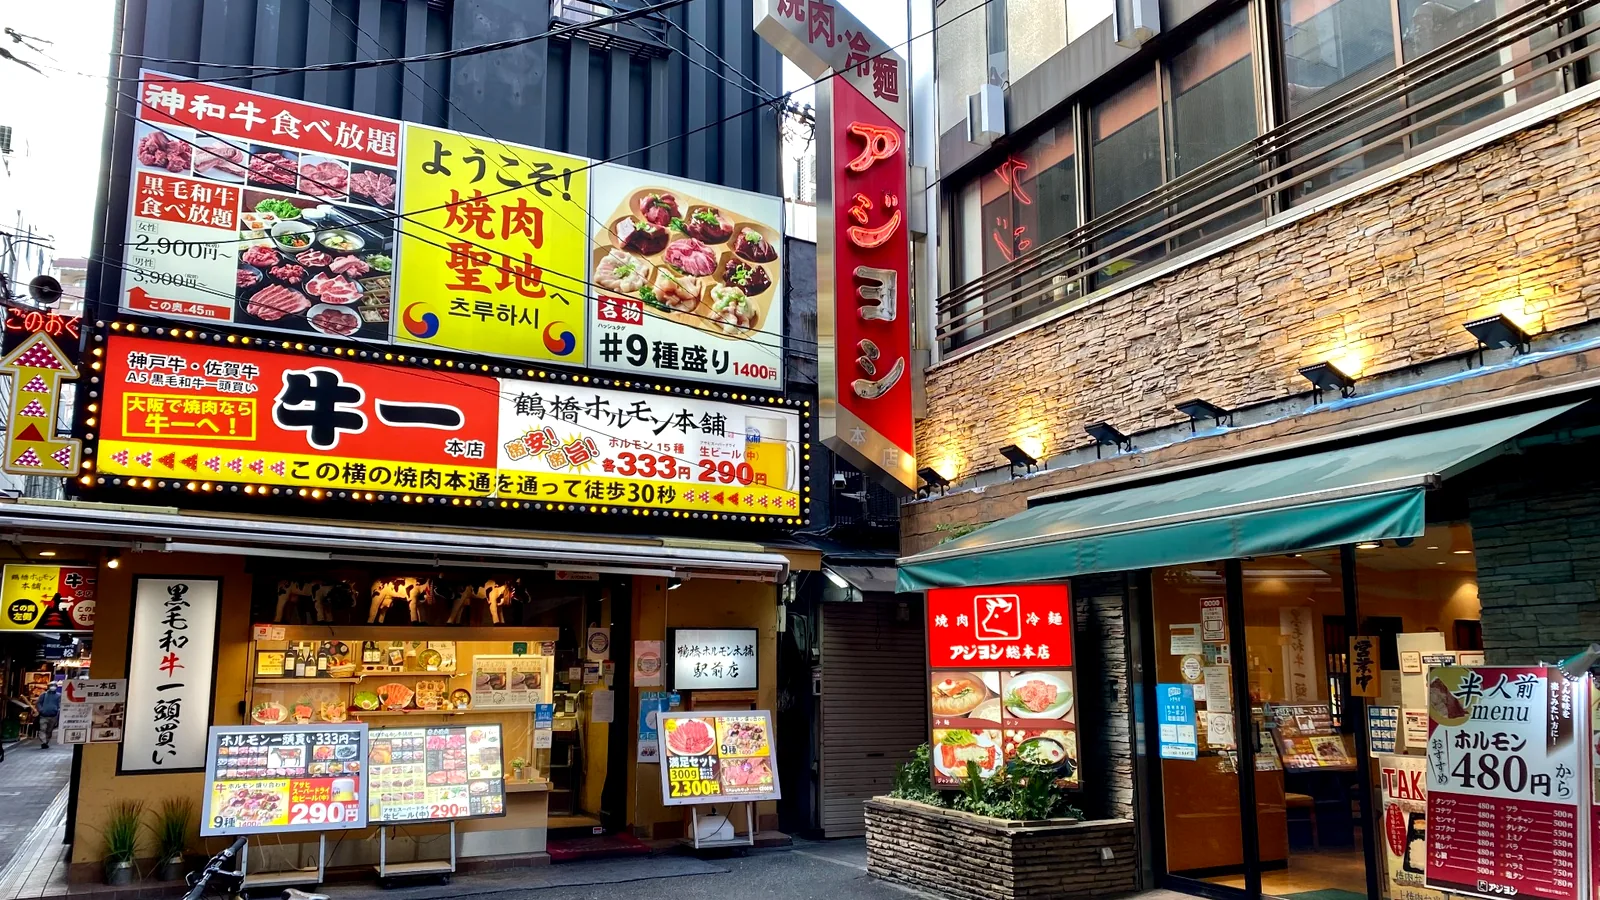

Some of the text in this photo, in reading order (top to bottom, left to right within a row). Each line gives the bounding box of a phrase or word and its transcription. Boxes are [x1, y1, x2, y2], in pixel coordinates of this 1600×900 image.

[145, 84, 397, 158] 神和牛食べ放題
[141, 175, 235, 207] 黒毛和牛
[140, 196, 234, 228] 食べ放題
[443, 188, 545, 249] 焼肉
[138, 222, 156, 232] 女性
[135, 257, 154, 267] 男性
[846, 121, 905, 400] アジヨシ
[6, 308, 79, 339] このおく
[447, 296, 540, 330] 츠루하시
[600, 298, 642, 323] 名物
[128, 352, 260, 380] 神戸牛・佐賀牛
[732, 361, 778, 381] 1400円
[127, 397, 252, 416] 大阪で焼肉なら
[272, 366, 465, 450] 牛一
[513, 391, 728, 439] 鶴橋ホルモン本舗
[445, 438, 486, 459] 本店
[290, 460, 677, 505] この横の焼肉本通を通って徒歩30秒
[698, 459, 768, 486] 290円
[935, 612, 970, 628] 焼肉
[949, 643, 1051, 660] アジヨシ総本店
[152, 583, 191, 765] 黒毛和牛一頭買い
[693, 661, 739, 679] 駅前店
[1353, 639, 1375, 693] 営業中
[1453, 672, 1539, 706] 半人前
[1470, 704, 1530, 721] menu
[1455, 729, 1527, 752] ホルモン
[669, 756, 717, 768] 満足セット
[1432, 738, 1448, 785] おすすめ
[1451, 751, 1552, 797] 480円
[1383, 768, 1427, 801] TAK
[290, 802, 360, 825] 290円
[430, 803, 468, 818] 290円
[1488, 883, 1518, 896] アジヨシ
